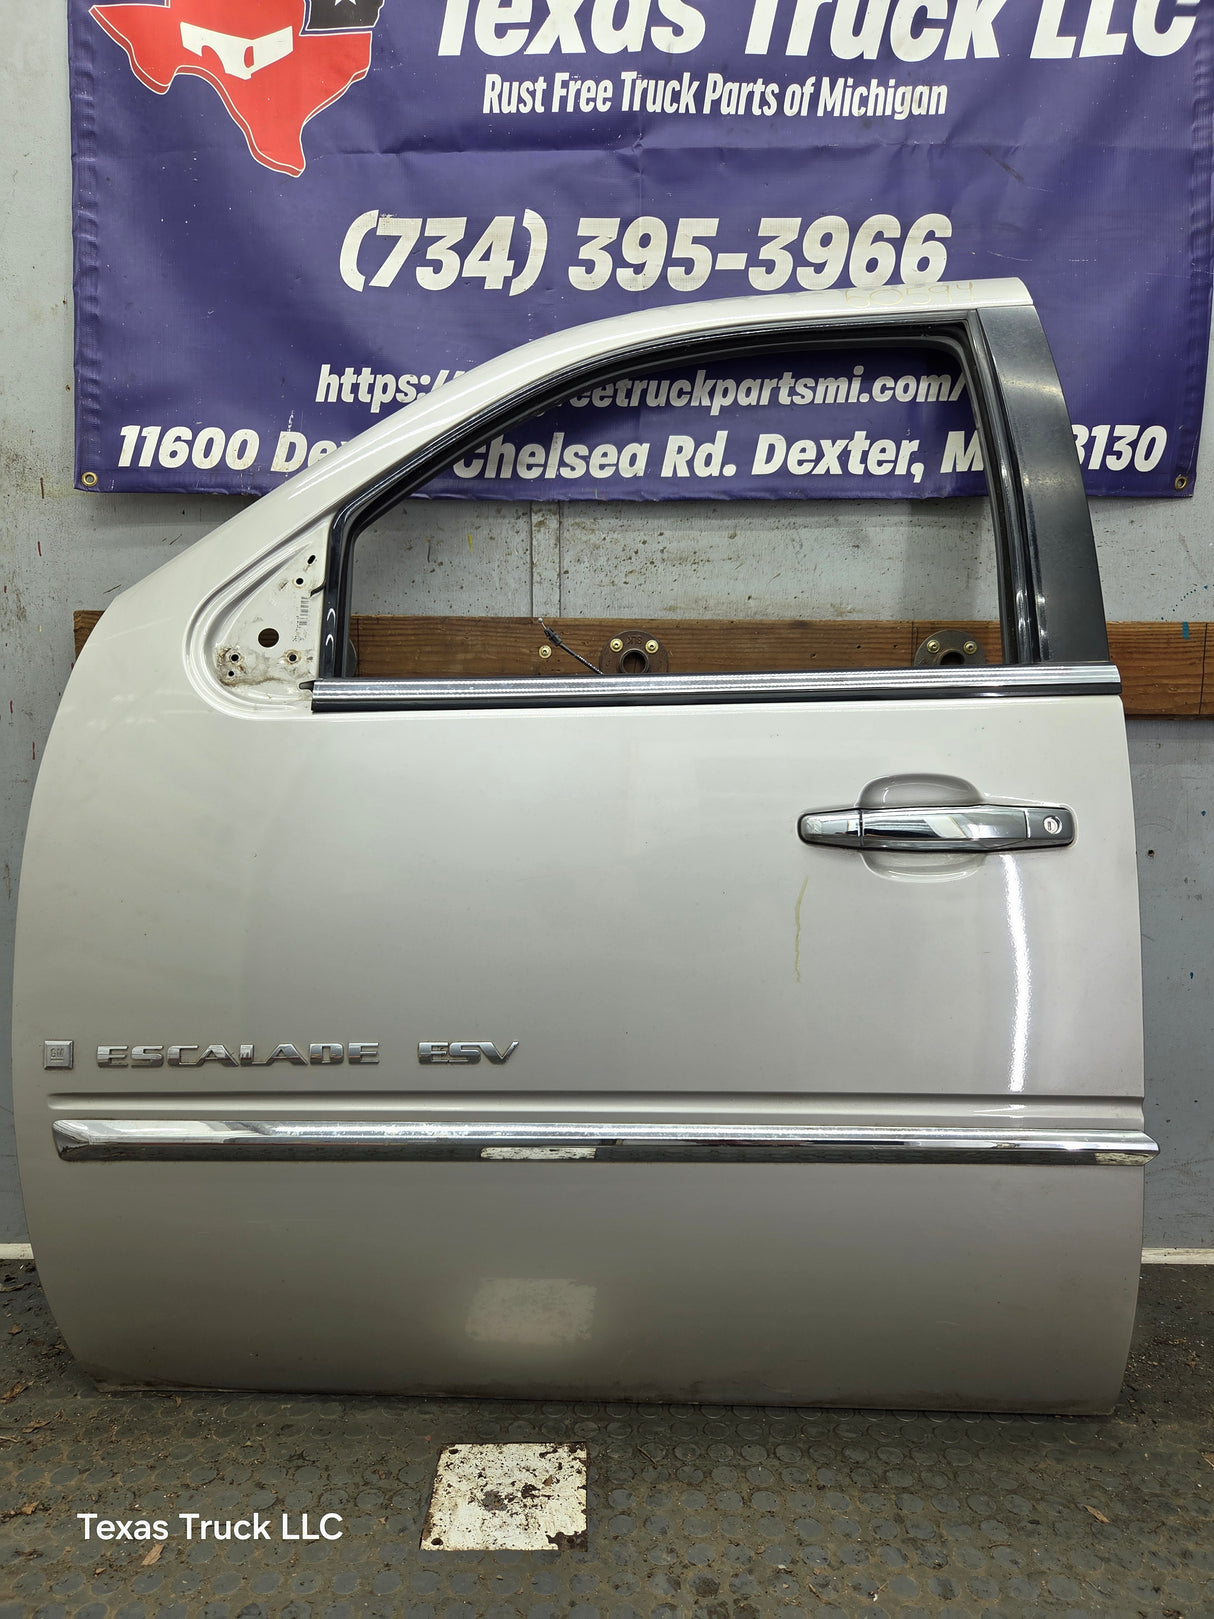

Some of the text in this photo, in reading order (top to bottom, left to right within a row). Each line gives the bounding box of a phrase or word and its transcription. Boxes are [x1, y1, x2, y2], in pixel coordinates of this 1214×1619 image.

[1029, 0, 1199, 58] LLC
[482, 71, 948, 121] Rust Free Truck Parts of Michigan
[339, 208, 953, 297] (734) 395-3966
[118, 424, 260, 470] 11600
[662, 430, 737, 477] Rd.
[752, 430, 926, 484] Dexter,
[939, 430, 985, 474] M
[96, 1040, 519, 1068] ESCALADE ESV
